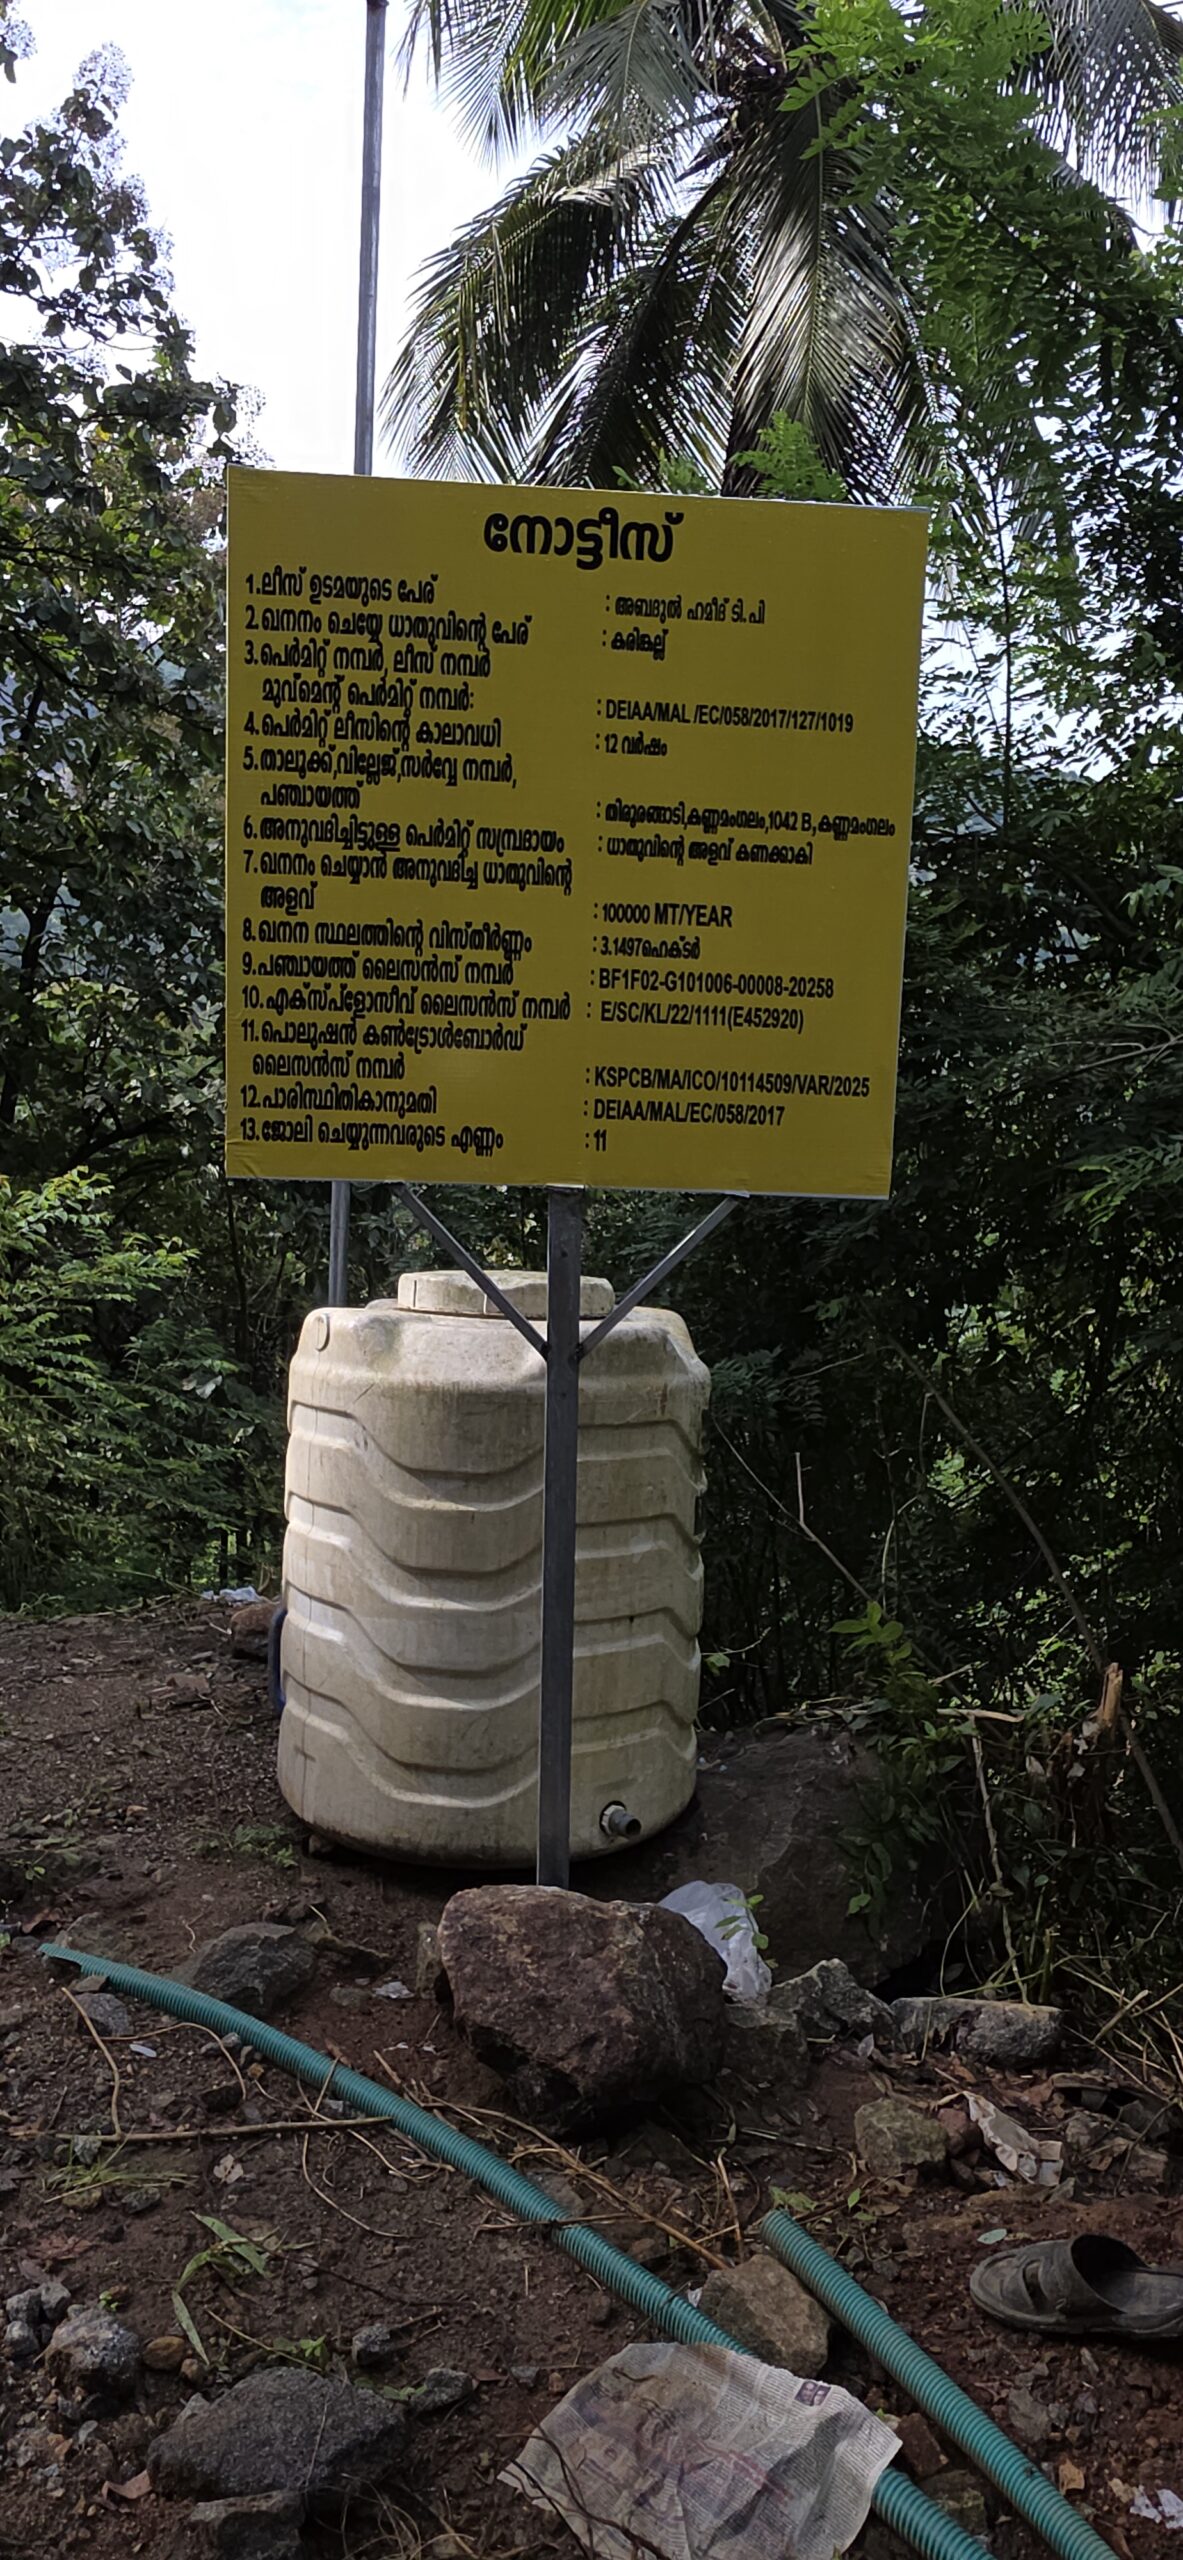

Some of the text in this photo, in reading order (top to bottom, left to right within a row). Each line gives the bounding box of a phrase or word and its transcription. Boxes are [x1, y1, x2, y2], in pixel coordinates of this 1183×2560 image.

[484, 507, 684, 570] നോട്ടീസ്
[309, 574, 393, 607] ഉടമയുടെ
[398, 573, 439, 604] പേര്
[492, 614, 533, 645] പേര്
[393, 643, 438, 674] ലീസ്
[441, 647, 491, 677] നമ്പർ
[348, 677, 418, 717] പെർമിറ്റ്
[606, 699, 691, 724] DEIAA/MAL
[334, 710, 411, 751] ലീസിന്റെ
[416, 717, 501, 748] കാലാവധി
[604, 733, 618, 754] 12
[622, 731, 668, 756] വർഷം
[261, 780, 364, 809] പഞ്ചായത്ത്
[406, 818, 474, 858] പെർമിറ്റ്
[688, 837, 735, 865] അളവ്
[320, 850, 387, 884] ചെയ്യാൻ
[392, 850, 478, 890] അനുവദിച്ച
[483, 857, 573, 896] ധാതുവിന്റെ
[260, 880, 318, 916] അളവ്
[603, 903, 650, 924] 100000
[654, 903, 733, 928] MT/YEAR
[315, 917, 424, 957] സ്ഥലത്തിന്റെ
[362, 954, 463, 983] ലൈസൻസ്
[464, 960, 514, 985] നമ്പർ
[421, 989, 520, 1018] ലൈസൻസ്
[522, 992, 571, 1020] നമ്പർ
[253, 1049, 405, 1080] ലൈസൻസ് നമ്പർ
[593, 1098, 785, 1126] DEIAA/MAL/EC/058/2017
[318, 1121, 446, 1152] ചെയ്യുന്നവരുടെ
[451, 1125, 504, 1157] എണ്ണം
[594, 1129, 607, 1152] 11
